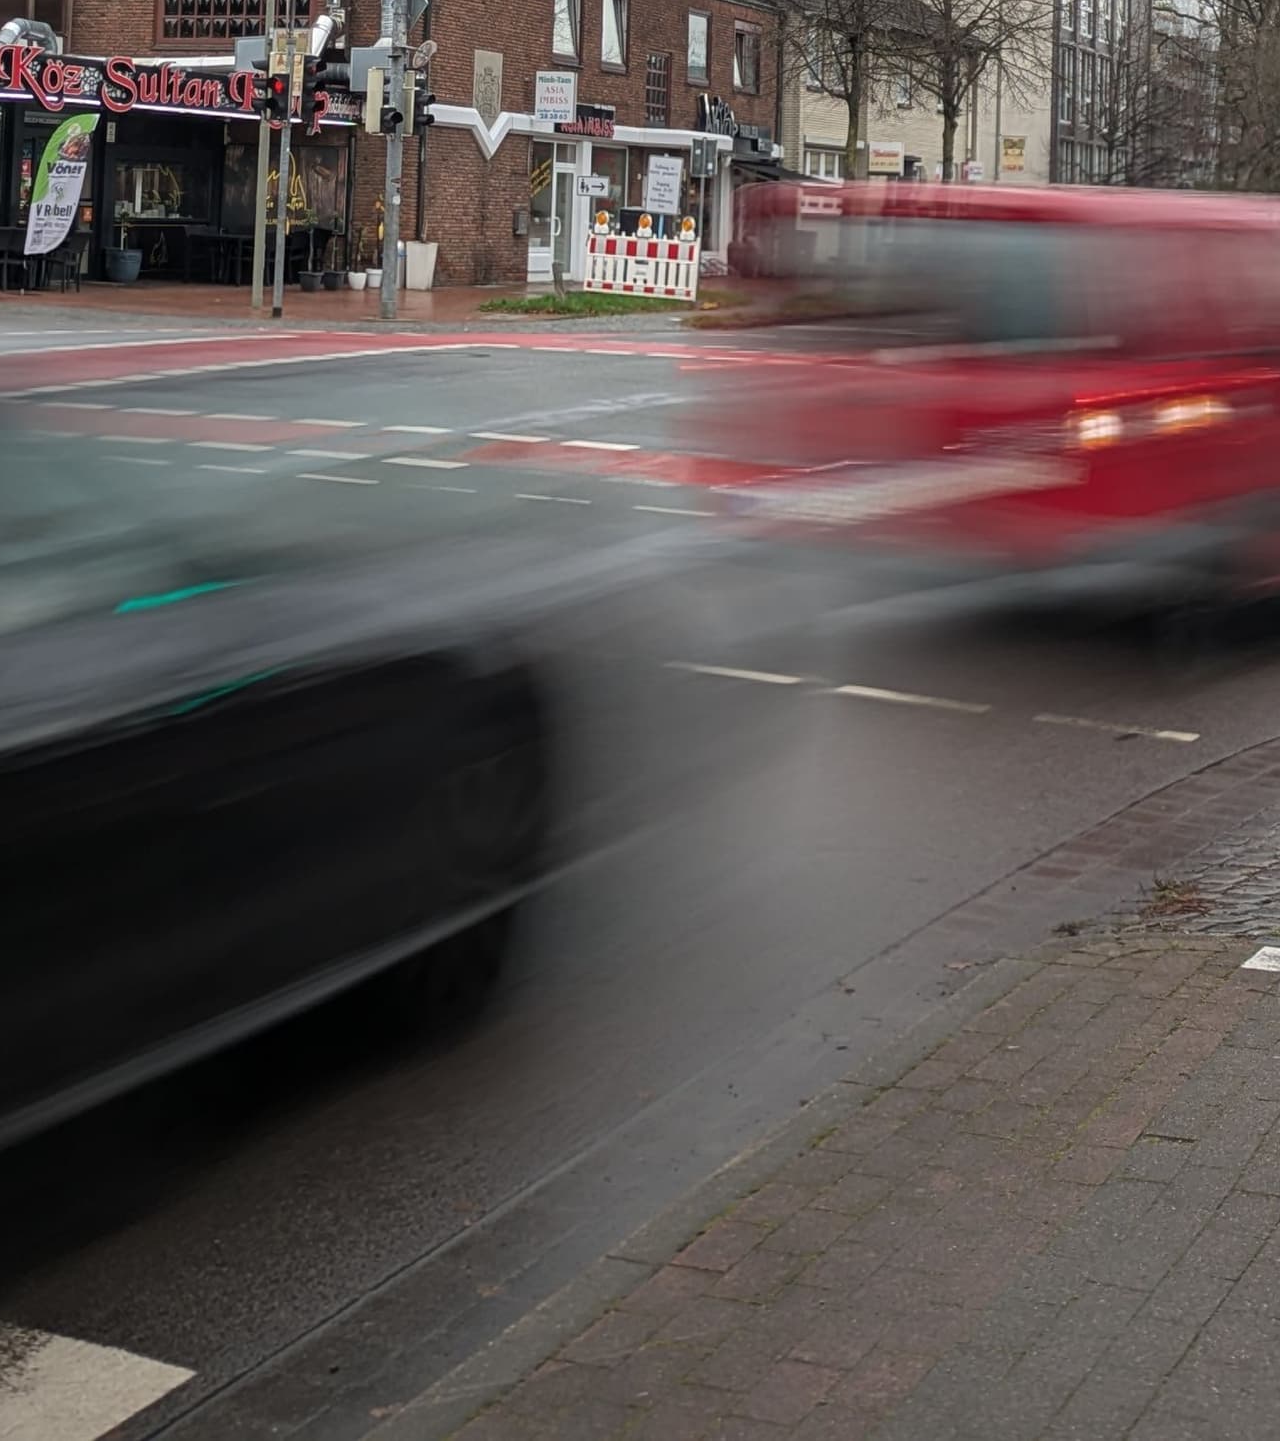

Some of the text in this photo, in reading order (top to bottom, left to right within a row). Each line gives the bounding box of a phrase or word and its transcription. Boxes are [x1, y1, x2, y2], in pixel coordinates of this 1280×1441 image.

[102, 56, 221, 113] Sultan
[544, 85, 565, 95] ASIA
[539, 96, 569, 106] IMBISS
